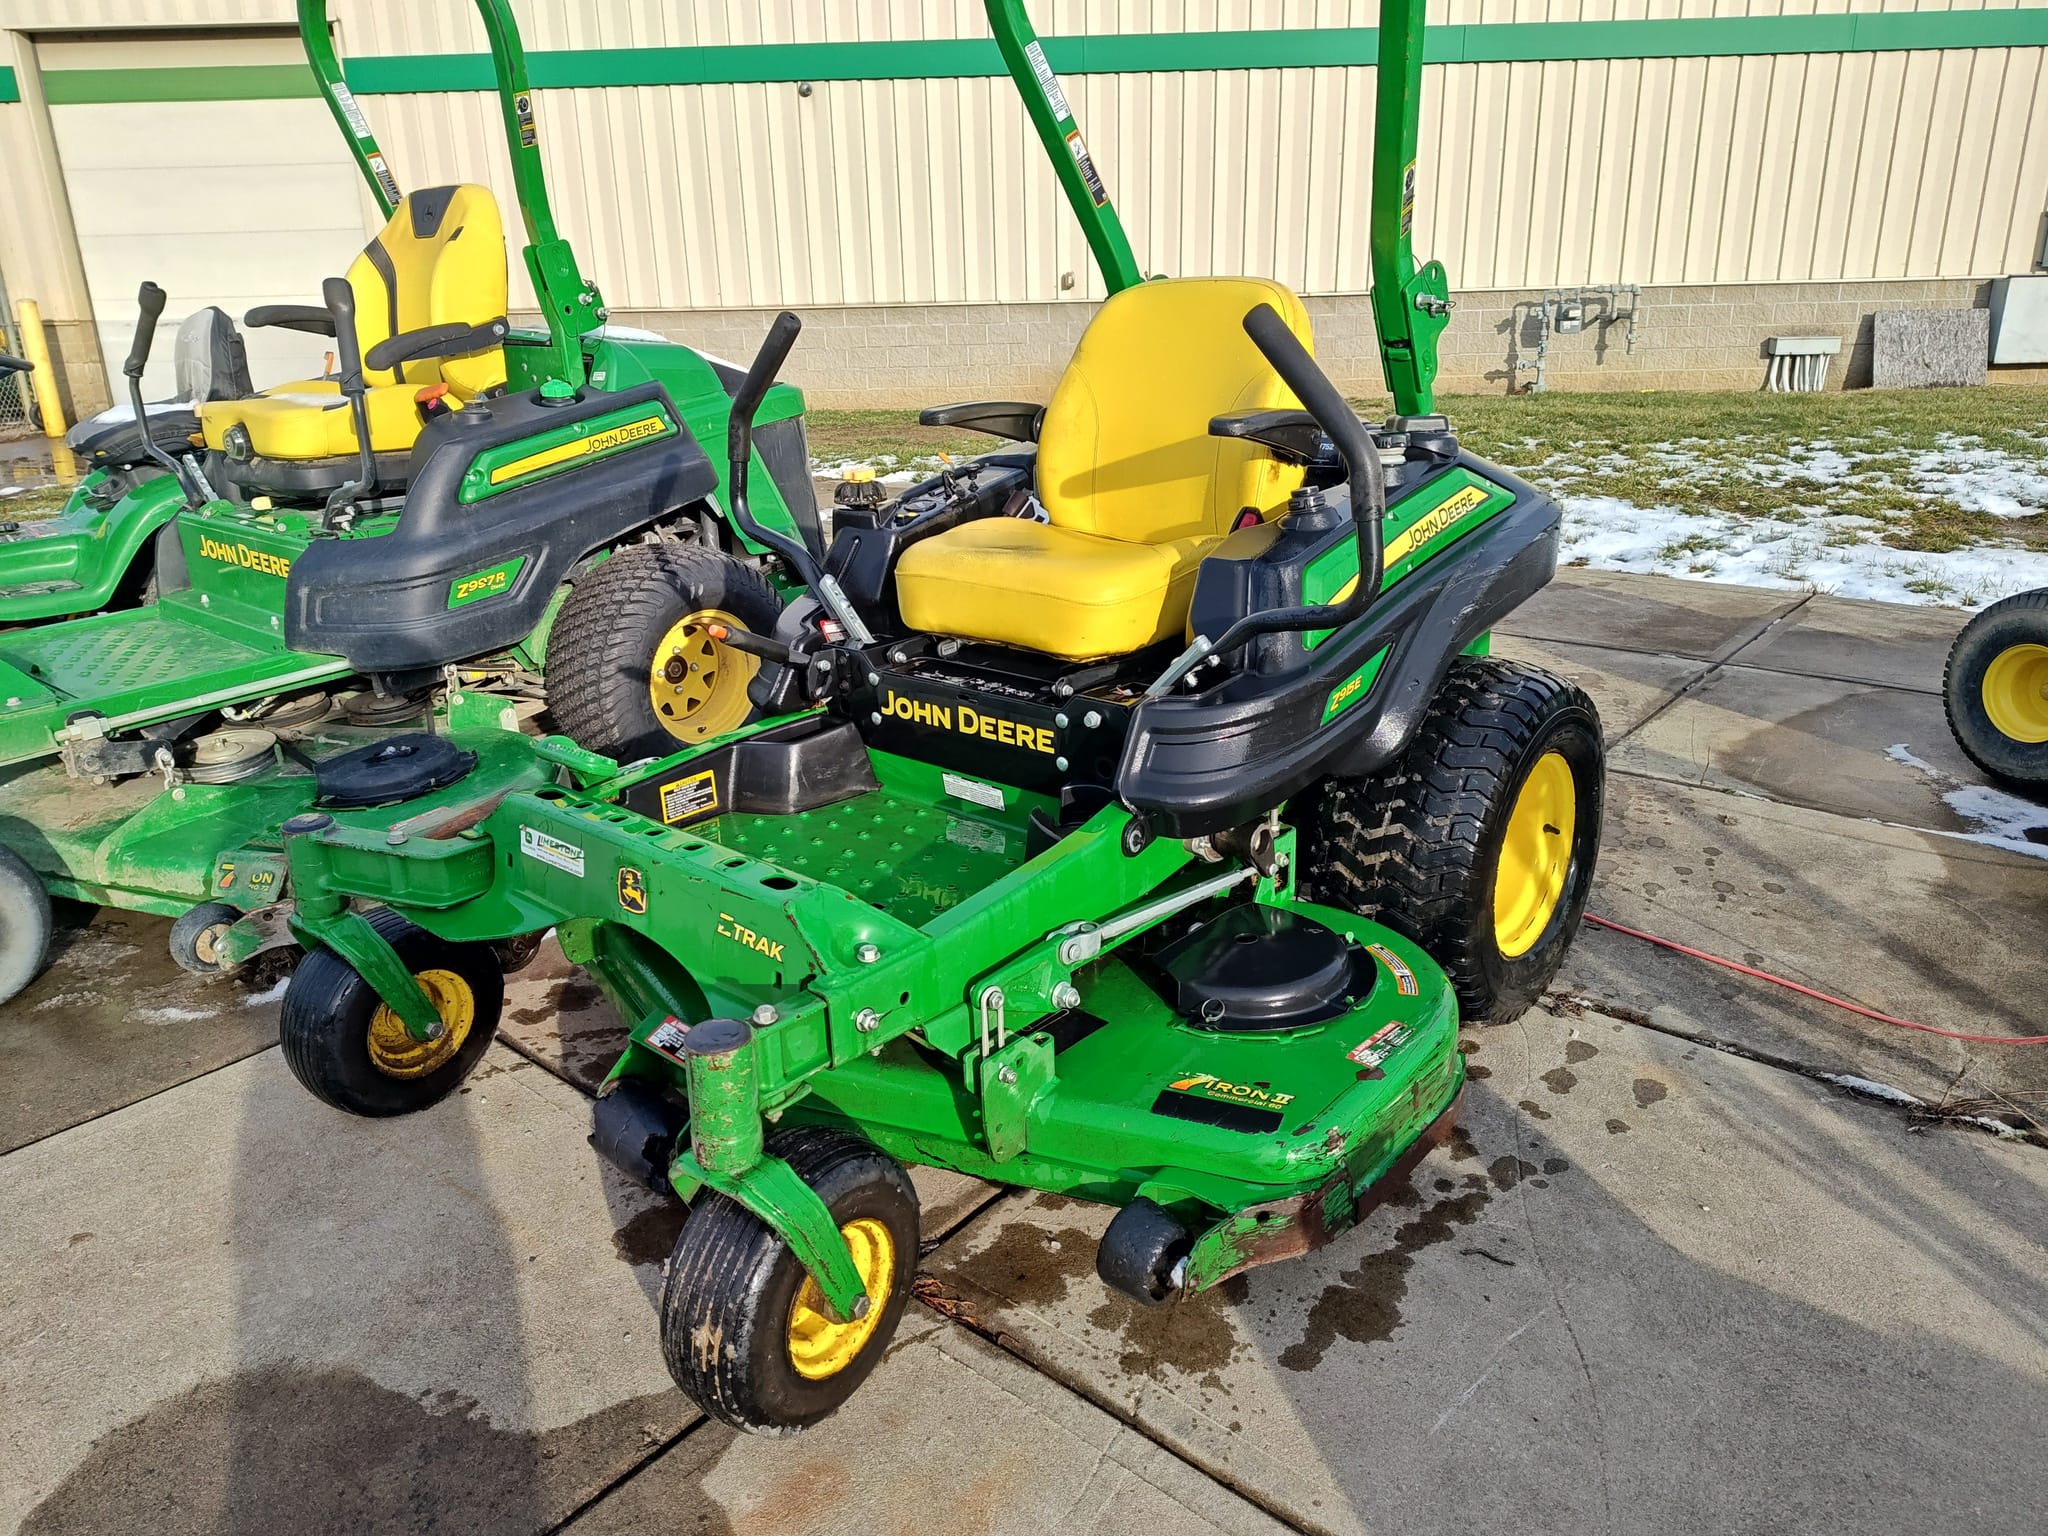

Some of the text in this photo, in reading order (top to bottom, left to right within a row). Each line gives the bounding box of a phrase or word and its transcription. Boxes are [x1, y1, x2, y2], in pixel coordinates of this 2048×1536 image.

[586, 421, 658, 453] JOHN DEERE
[1408, 491, 1475, 550] JOHN DEERE
[200, 534, 291, 579] JOHN DEERE
[456, 571, 506, 599] Z997R
[881, 690, 1056, 754] JOHN DEERE
[716, 911, 786, 962] ZTRAK
[1206, 1090, 1283, 1111] Commercial 60
[1270, 1092, 1296, 1105] II
